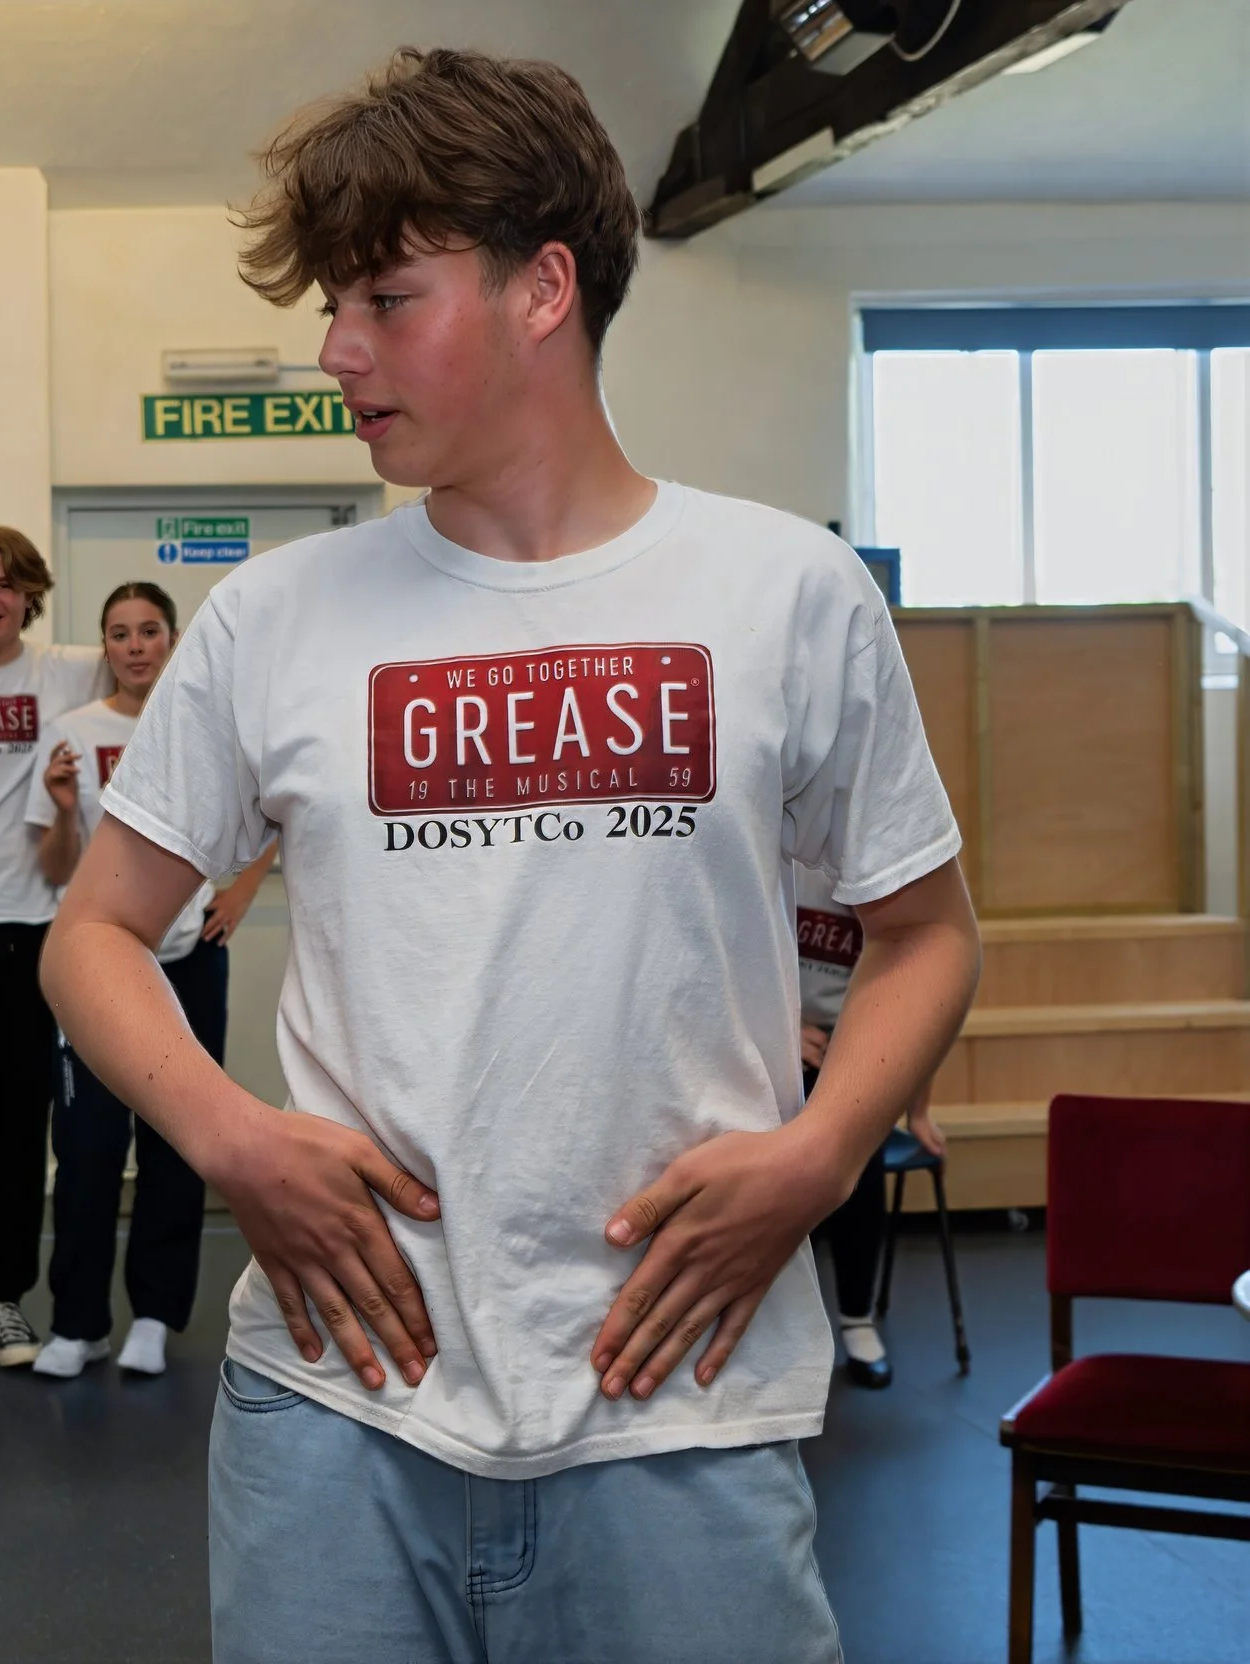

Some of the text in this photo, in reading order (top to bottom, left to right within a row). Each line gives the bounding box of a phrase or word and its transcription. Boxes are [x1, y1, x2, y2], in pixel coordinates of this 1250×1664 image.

[154, 394, 354, 436] FIRE EXIT
[183, 518, 247, 536] Fire exit
[182, 544, 214, 561] Keep
[447, 656, 634, 689] WE GO TOGETHER
[403, 682, 690, 769] GREASE
[408, 767, 691, 801] 19 THE MUSICAL 59
[383, 805, 698, 852] DOSYTCo 2025
[797, 920, 854, 955] GREA
